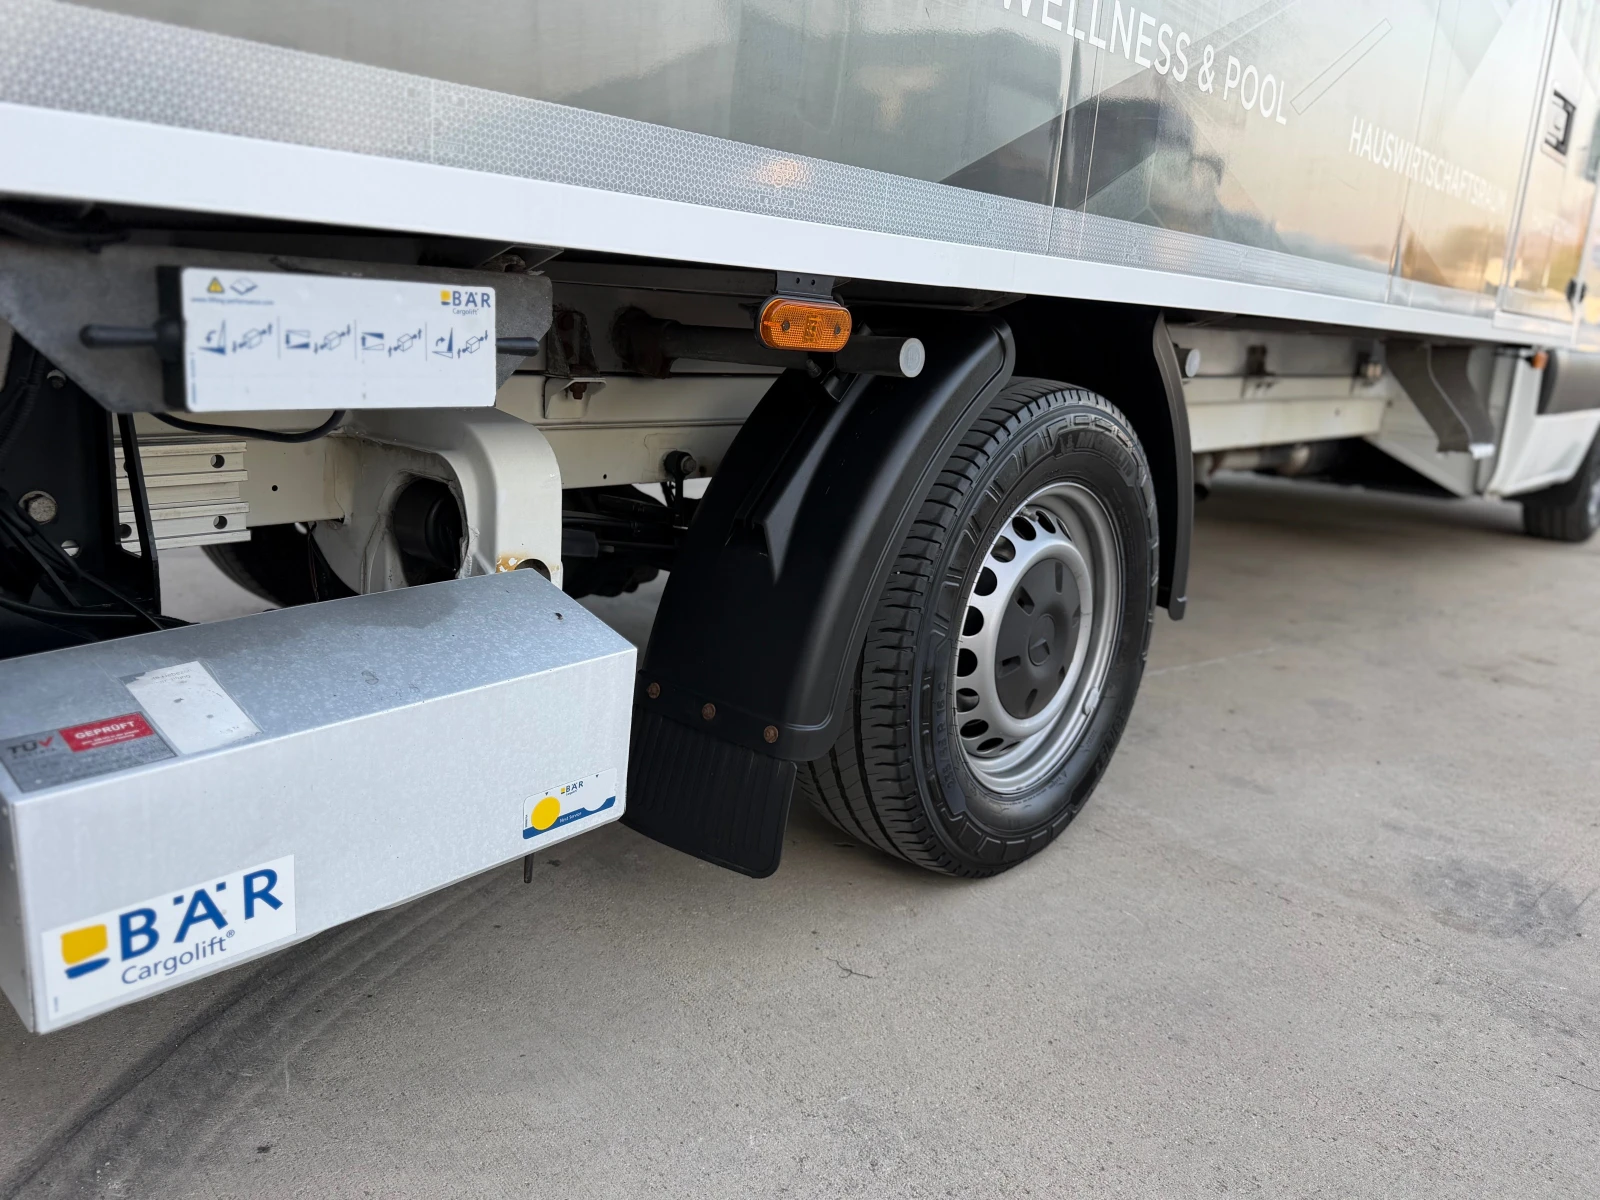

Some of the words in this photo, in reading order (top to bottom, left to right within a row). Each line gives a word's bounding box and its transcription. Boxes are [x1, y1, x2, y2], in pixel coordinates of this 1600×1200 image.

[1197, 44, 1216, 95] &
[1223, 55, 1287, 125] POOL
[452, 290, 491, 308] BÄR
[74, 720, 136, 741] GEPRÜFT
[565, 780, 584, 793] BÄR
[118, 868, 284, 962] BÄR
